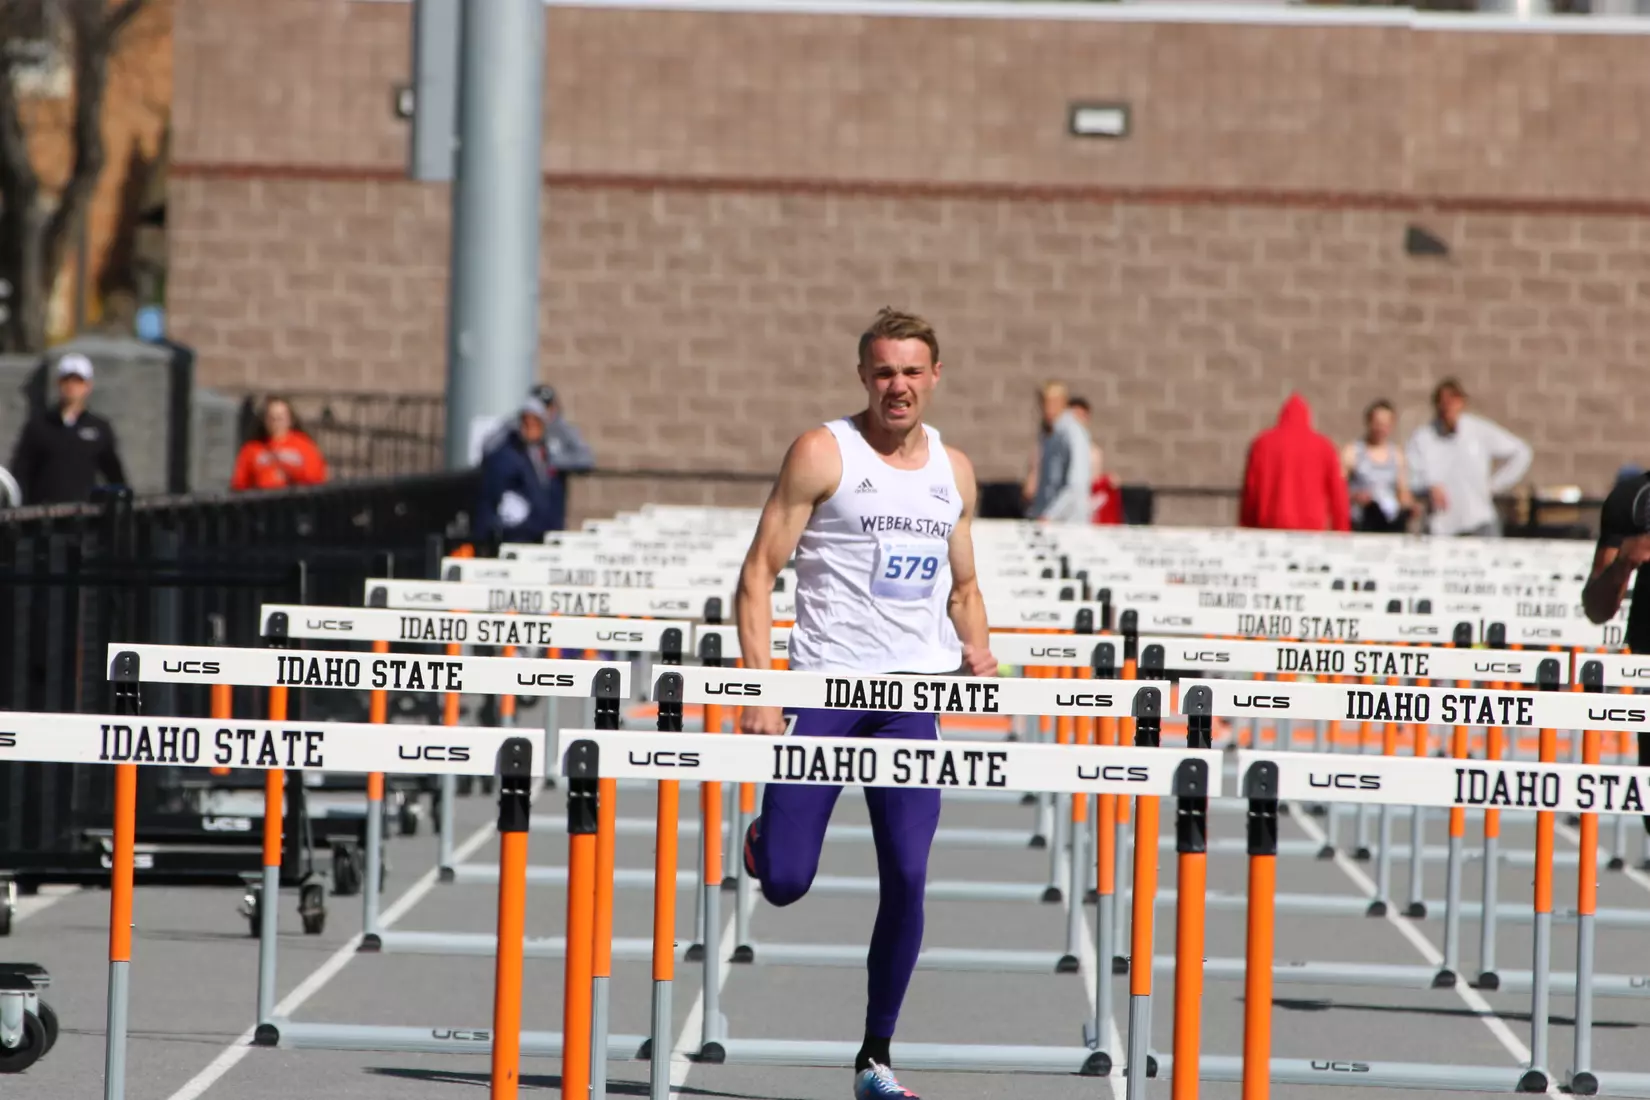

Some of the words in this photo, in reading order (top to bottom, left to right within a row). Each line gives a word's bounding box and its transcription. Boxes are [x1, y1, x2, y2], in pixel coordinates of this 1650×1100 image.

[860, 516, 911, 533] WEBER
[885, 555, 938, 580] 579
[488, 590, 542, 611] IDAHO
[551, 593, 611, 614] STATE
[306, 618, 353, 631] UCS
[400, 617, 468, 641] IDAHO
[478, 621, 552, 645] STATE
[1237, 614, 1292, 635] IDAHO
[1300, 617, 1360, 639] STATE
[596, 630, 643, 643] UCS
[1030, 647, 1077, 658] UCS
[1183, 651, 1230, 663] UCS
[163, 660, 220, 675] UCS
[1276, 648, 1345, 671] IDAHO
[1355, 652, 1429, 676] STATE
[1474, 662, 1522, 674] UCS
[277, 656, 360, 686] IDAHO
[372, 659, 463, 691] STATE
[517, 673, 574, 687] UCS
[1621, 667, 1650, 678] UC
[704, 682, 762, 696] UCS
[825, 678, 903, 709] IDAHO
[913, 681, 999, 712] STATE
[1056, 694, 1113, 707] UCS
[1233, 694, 1290, 708] UCS
[1346, 691, 1430, 721] IDAHO
[1442, 695, 1533, 725] STATE
[1588, 708, 1645, 722] UCS
[100, 725, 199, 761] IDAHO
[214, 729, 324, 767] STATE
[398, 745, 470, 761] UCS
[629, 751, 700, 767] UCS
[772, 745, 877, 783] IDAHO
[893, 749, 1007, 787] STATE
[1077, 765, 1149, 782] UCS
[1309, 773, 1381, 790] UCS
[1455, 769, 1560, 807] IDAHO
[1577, 774, 1650, 811] STA
[101, 853, 154, 869] US
[431, 1029, 490, 1041] UCS
[1311, 1060, 1369, 1072] UCS
